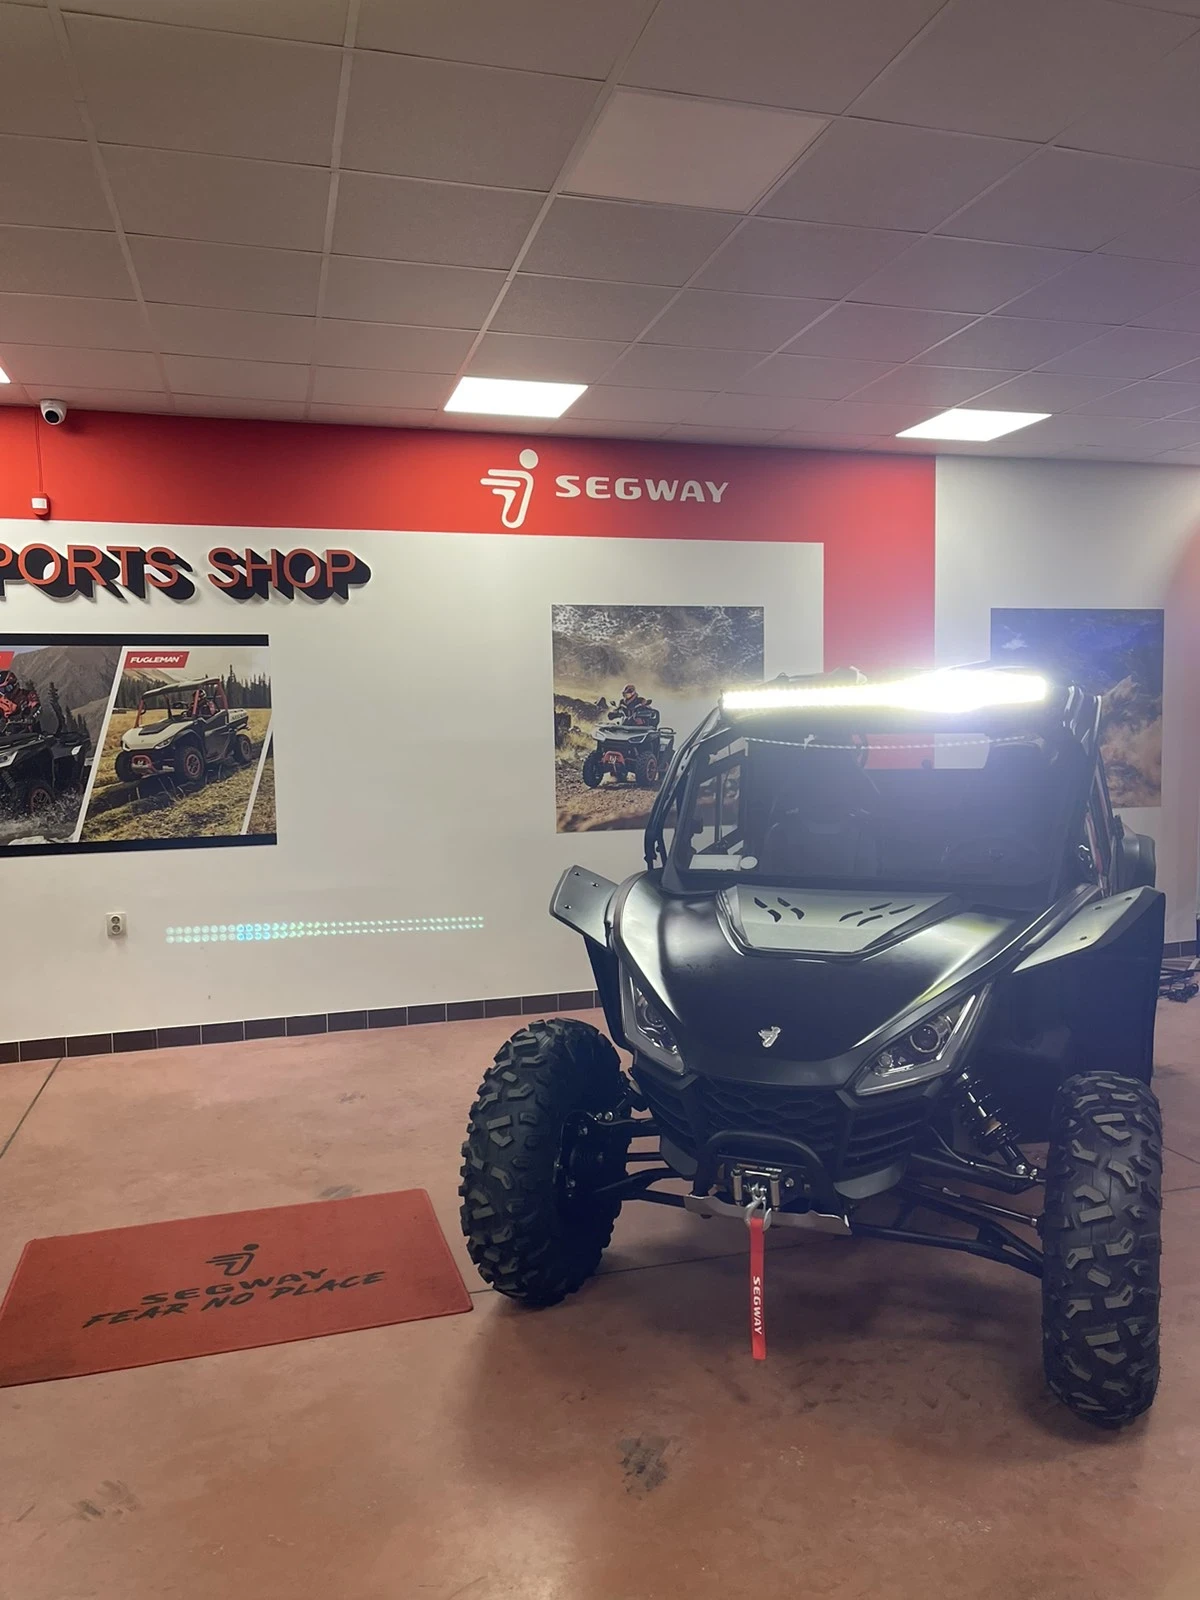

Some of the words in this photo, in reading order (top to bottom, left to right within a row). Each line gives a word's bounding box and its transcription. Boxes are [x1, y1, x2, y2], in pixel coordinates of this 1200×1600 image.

[555, 475, 729, 503] SEGWAY
[207, 547, 371, 600] SHOP
[82, 1303, 189, 1328] FEAR
[201, 1293, 254, 1311] NO
[270, 1271, 385, 1299] PLACE
[141, 1268, 328, 1305] SEGWAY
[753, 1276, 762, 1335] SEGWAY
